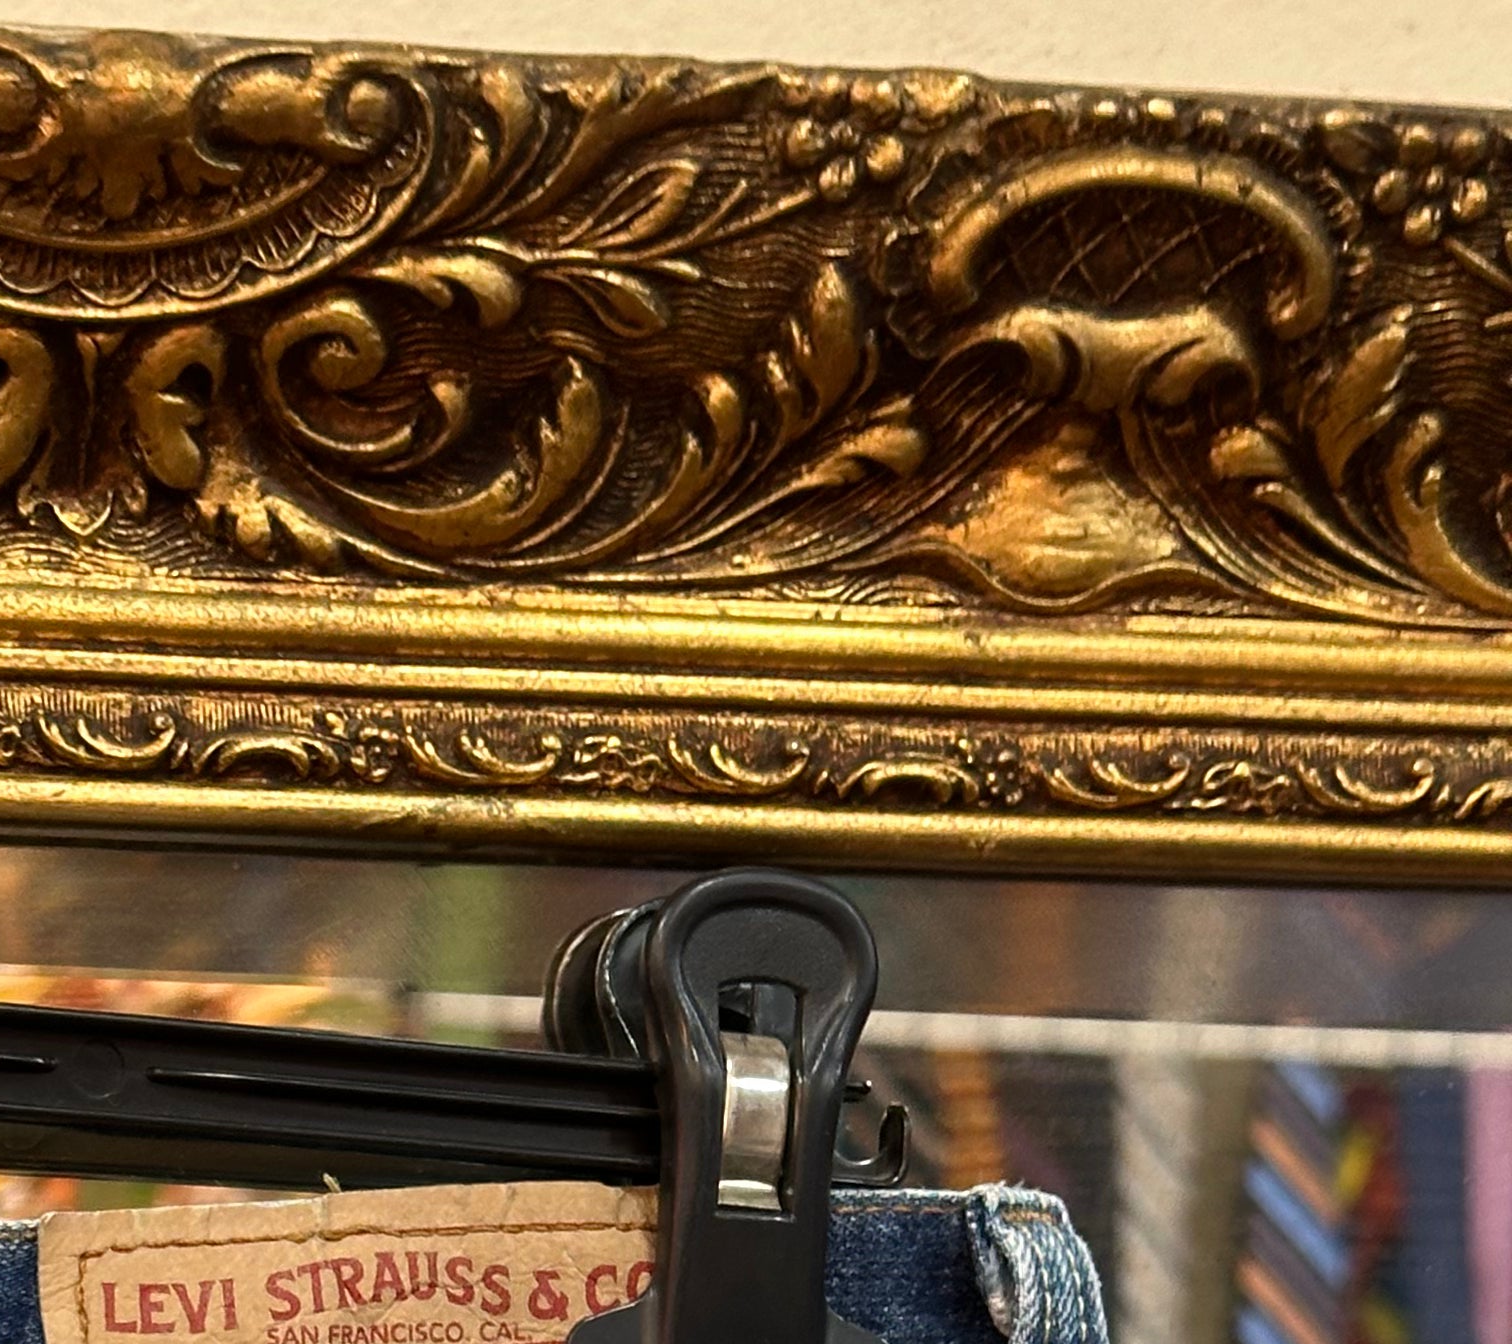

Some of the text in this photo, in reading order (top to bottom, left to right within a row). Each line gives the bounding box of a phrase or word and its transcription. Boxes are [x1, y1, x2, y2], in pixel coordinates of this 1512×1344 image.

[101, 1278, 238, 1334] LEVI
[265, 1251, 511, 1321] STRAUSS
[528, 1270, 569, 1321] &
[479, 1321, 533, 1342] CAL.
